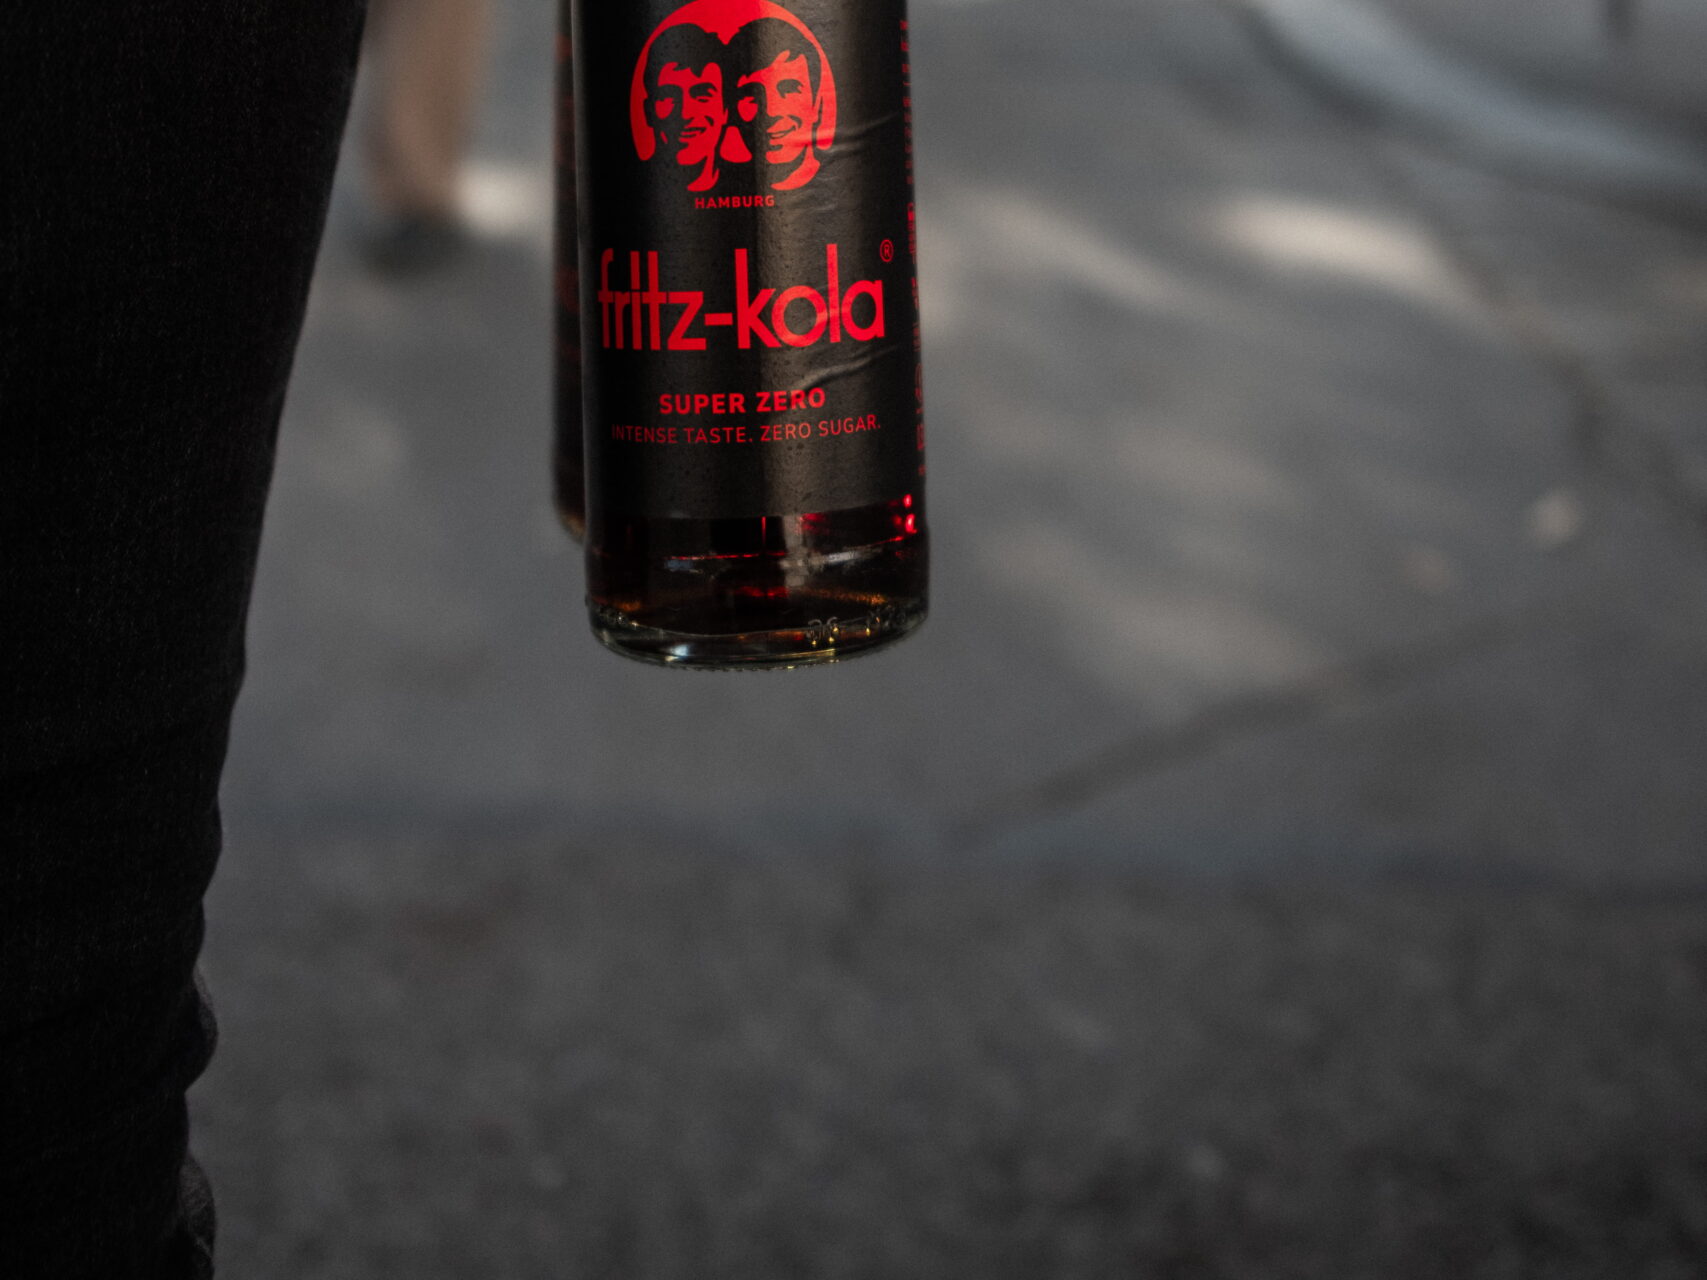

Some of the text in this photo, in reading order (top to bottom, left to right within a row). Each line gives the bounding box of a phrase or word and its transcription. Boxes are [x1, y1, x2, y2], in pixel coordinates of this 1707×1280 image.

[694, 195, 776, 209] HAMBURG
[598, 243, 885, 351] fritz-kola
[659, 387, 826, 414] SUPER ZERO
[611, 414, 881, 443] INTENSE TASTE. ZERO SUGAR.
